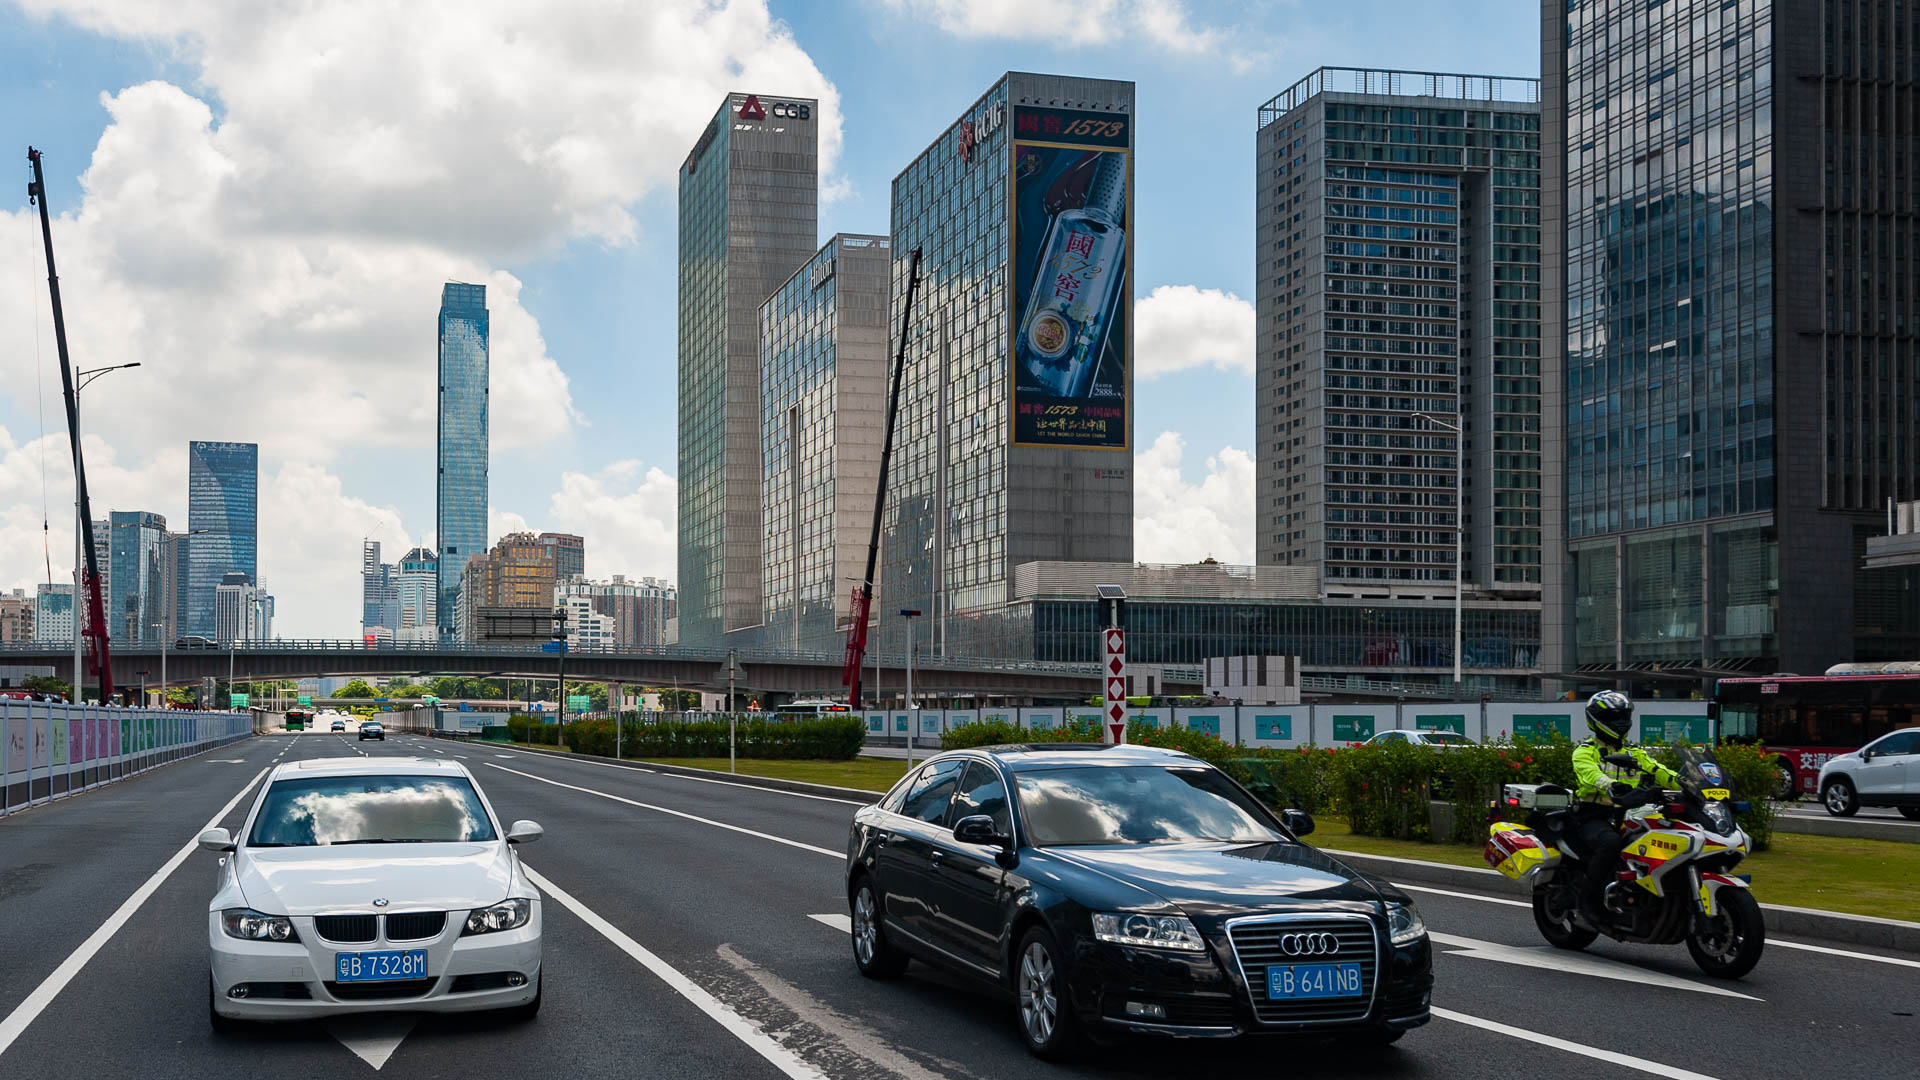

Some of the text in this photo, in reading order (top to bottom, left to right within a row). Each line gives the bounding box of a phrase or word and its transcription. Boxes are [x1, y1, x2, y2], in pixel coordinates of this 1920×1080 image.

[773, 103, 810, 120] CGB
[1064, 119, 1124, 138] 1573
[1065, 229, 1096, 260] 國
[811, 258, 832, 289] Hilton
[1047, 252, 1102, 280] 1573
[1054, 272, 1081, 302] 窖
[1044, 405, 1079, 415] 1573
